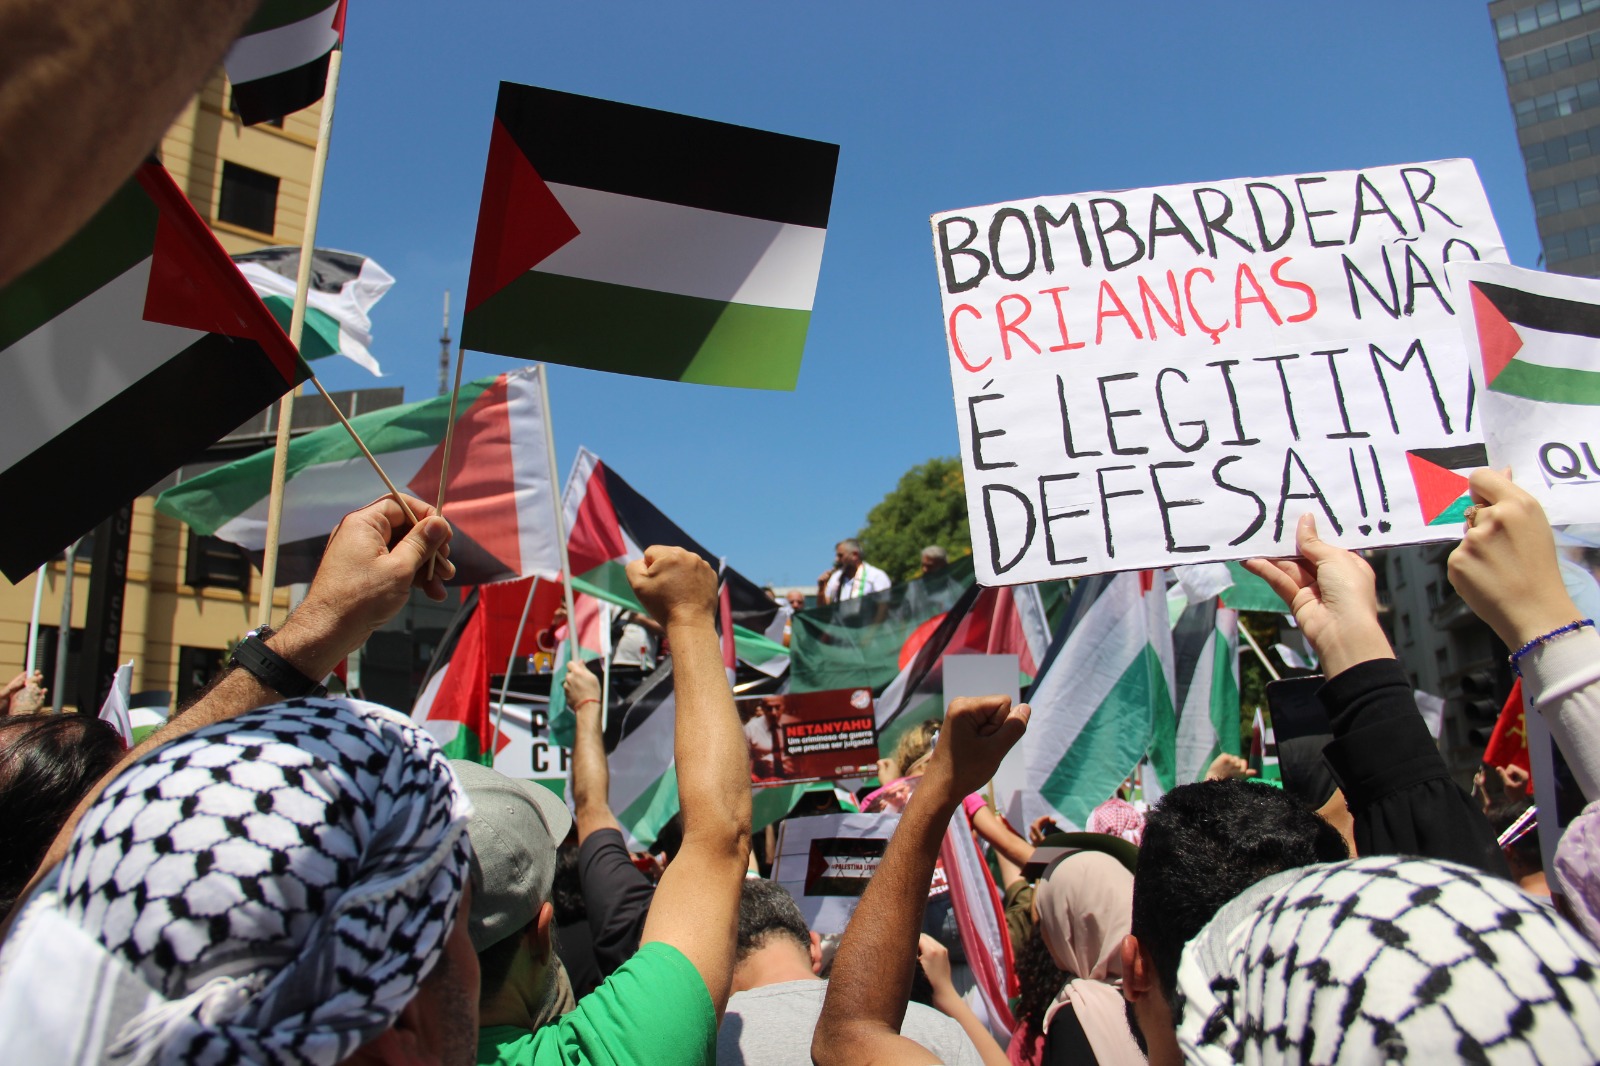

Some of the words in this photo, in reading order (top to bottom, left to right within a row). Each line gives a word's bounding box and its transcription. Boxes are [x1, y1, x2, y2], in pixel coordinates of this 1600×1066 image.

[938, 167, 1463, 294] BOMBARDEAR
[949, 256, 1318, 372] CRIANÇAS
[971, 379, 1018, 471] É
[1056, 338, 1476, 458] LEGITIM
[982, 444, 1393, 576] DEFESA!!
[113, 548, 125, 576] de
[786, 718, 872, 737] NETANYAHU
[787, 737, 801, 746] Um
[801, 734, 838, 744] criminoso
[838, 732, 849, 740] de
[848, 730, 873, 741] guerra
[787, 745, 803, 755] que
[803, 742, 831, 753] precisa
[830, 740, 843, 749] ser
